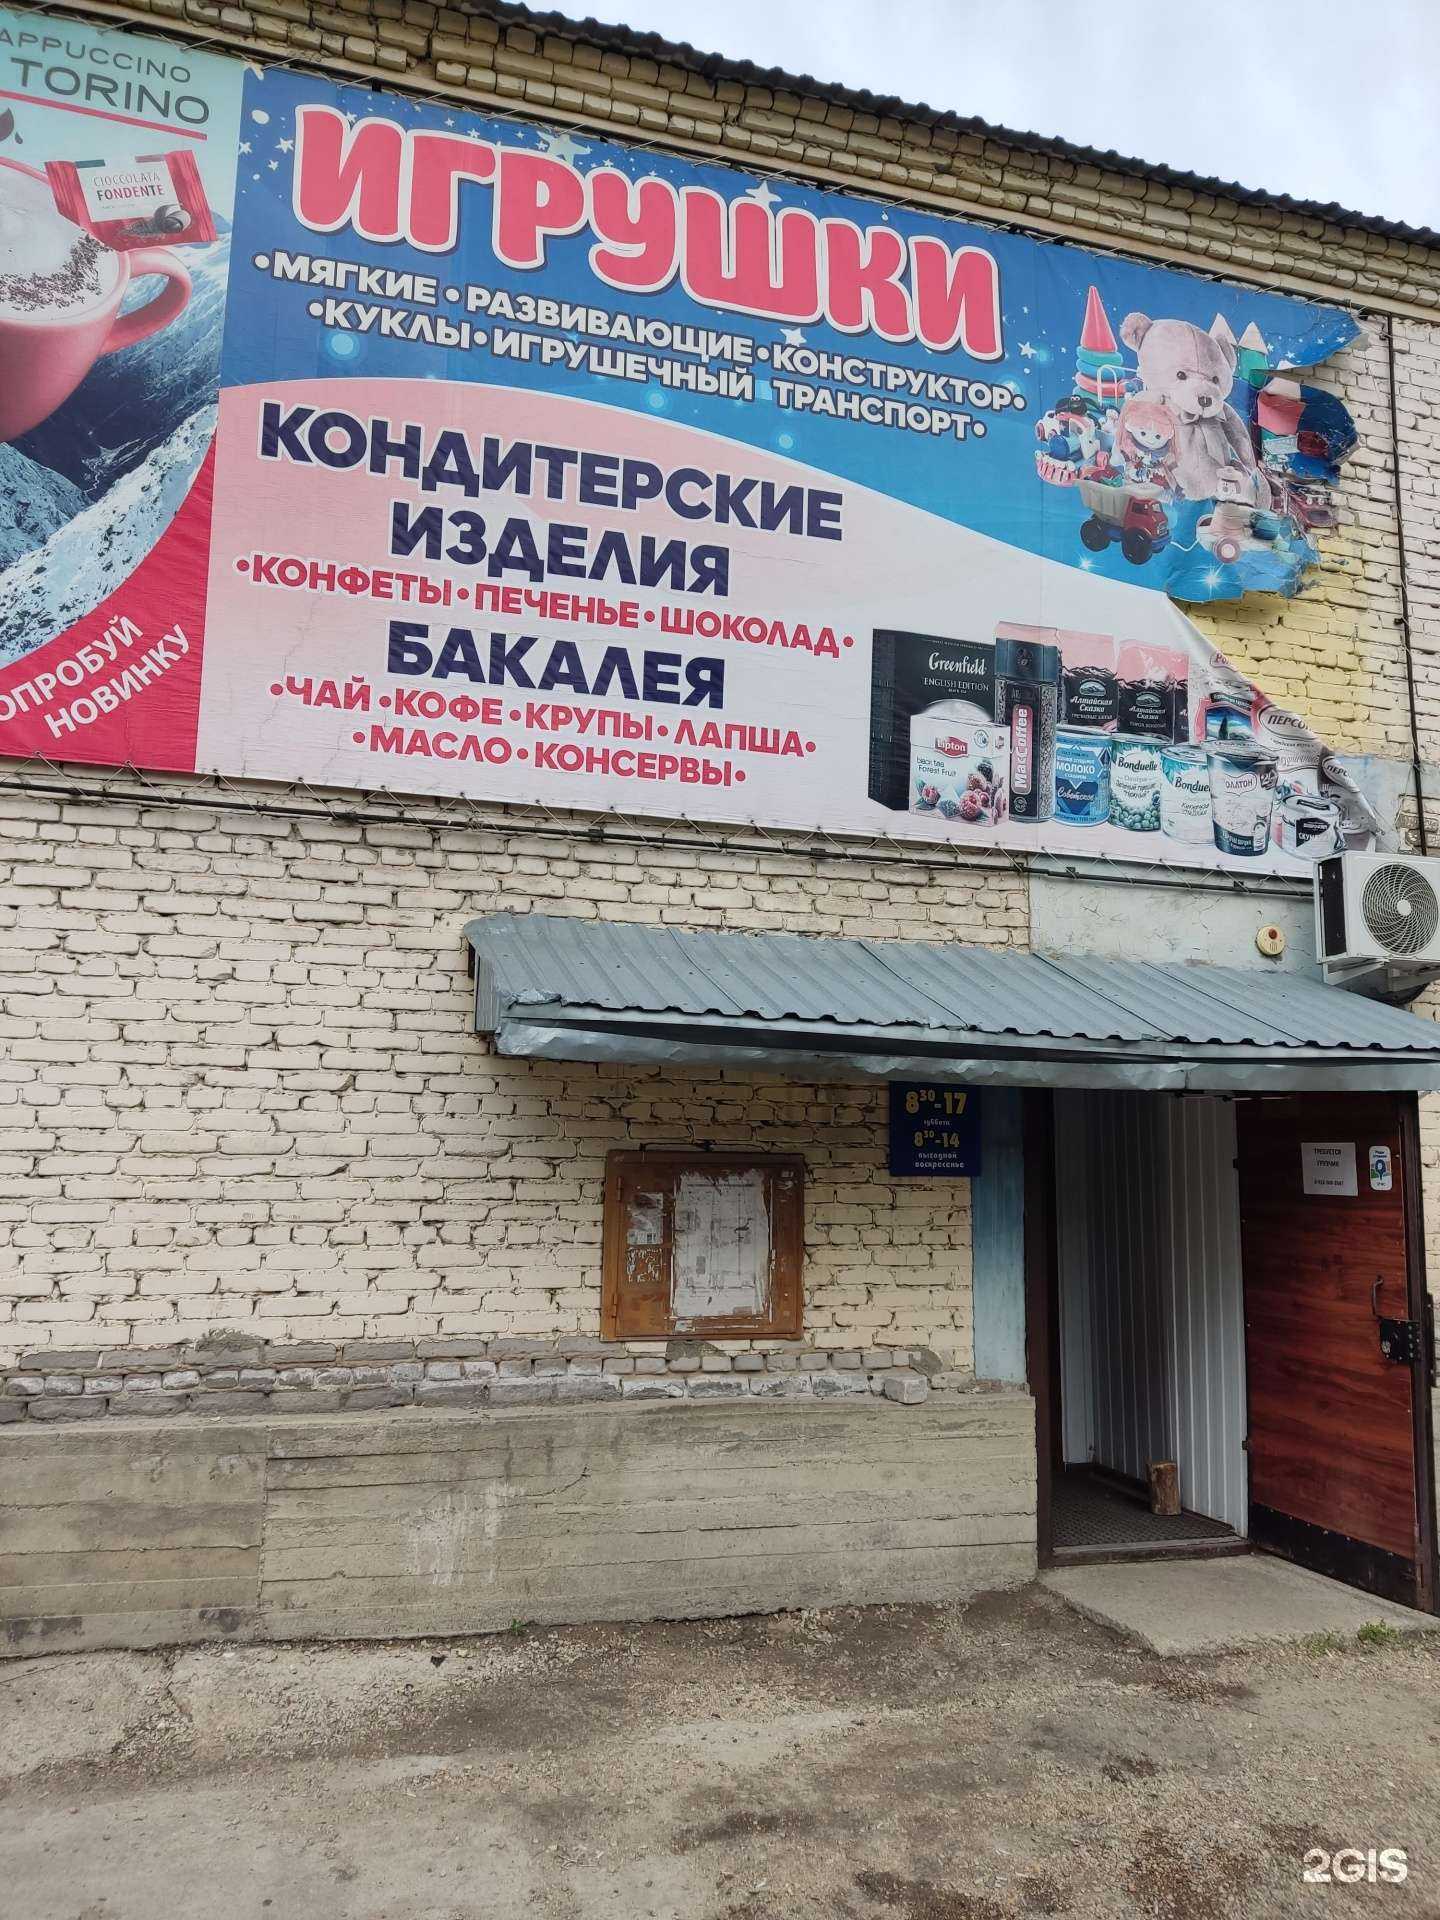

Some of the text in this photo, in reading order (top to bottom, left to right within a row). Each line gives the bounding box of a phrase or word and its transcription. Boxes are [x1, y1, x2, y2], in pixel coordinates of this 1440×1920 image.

[11, 57, 210, 124] TORINO
[93, 171, 161, 187] CIOCCOLATA
[96, 184, 165, 201] FONDENTE
[293, 104, 1003, 360] ИГРУШКИ
[272, 251, 1012, 410] МЯГКИЕ РАЗВИВАЮЩИЕ КОНСТРУКТОР
[325, 299, 971, 439] КУКЛЫ ИГРУШЕЧНЫЙ ТРАНСПОРТ
[261, 402, 843, 541] КОНДИТЕРСКИЕ
[391, 501, 730, 597] ИЗДЕЛИЯ
[252, 554, 840, 658] КОНФЕТЫ ПЕЧЕНЬЕ ШОКОЛАД
[44, 623, 190, 739] НОВИНКУ
[388, 620, 725, 709] БАКАЛЕЯ
[924, 678, 957, 689] ENGLISH
[958, 681, 989, 692] EDITION
[928, 652, 986, 675] Greenfield
[286, 675, 804, 757] ЧАЙ КОФЕ КРУПЫ ЛАПША
[369, 725, 732, 786] МАСЛО КОНСЕРВЫ
[937, 740, 967, 753] Lipton
[1014, 707, 1028, 789] MacCoffee
[1056, 762, 1095, 774] МОЛОКО
[1117, 757, 1158, 772] Bonduelle
